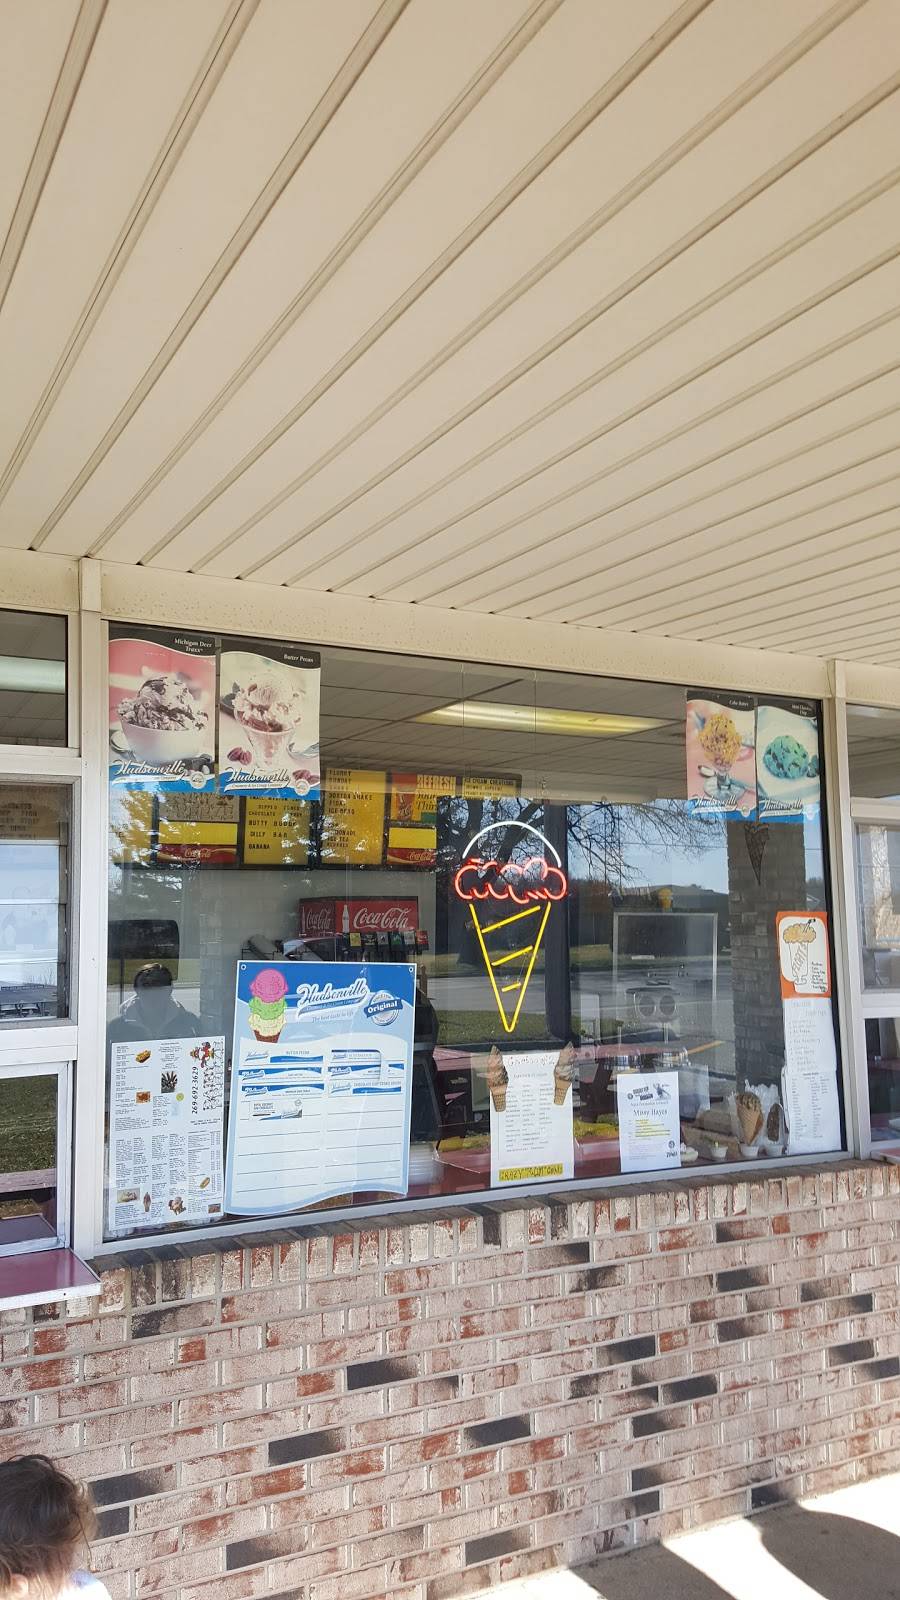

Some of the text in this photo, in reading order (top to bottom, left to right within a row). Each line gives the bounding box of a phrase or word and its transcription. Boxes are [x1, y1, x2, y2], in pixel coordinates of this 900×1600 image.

[175, 638, 212, 648] Michigan Deer
[283, 654, 298, 662] Butter
[112, 759, 188, 776] Hudsonville
[223, 766, 292, 783] Hudsonville
[694, 795, 737, 807] Hudsonville
[763, 796, 803, 810] Hudsonville
[353, 908, 412, 929] Coca-Cola
[298, 978, 368, 1006] Hudsonville
[368, 1000, 398, 1014] Original
